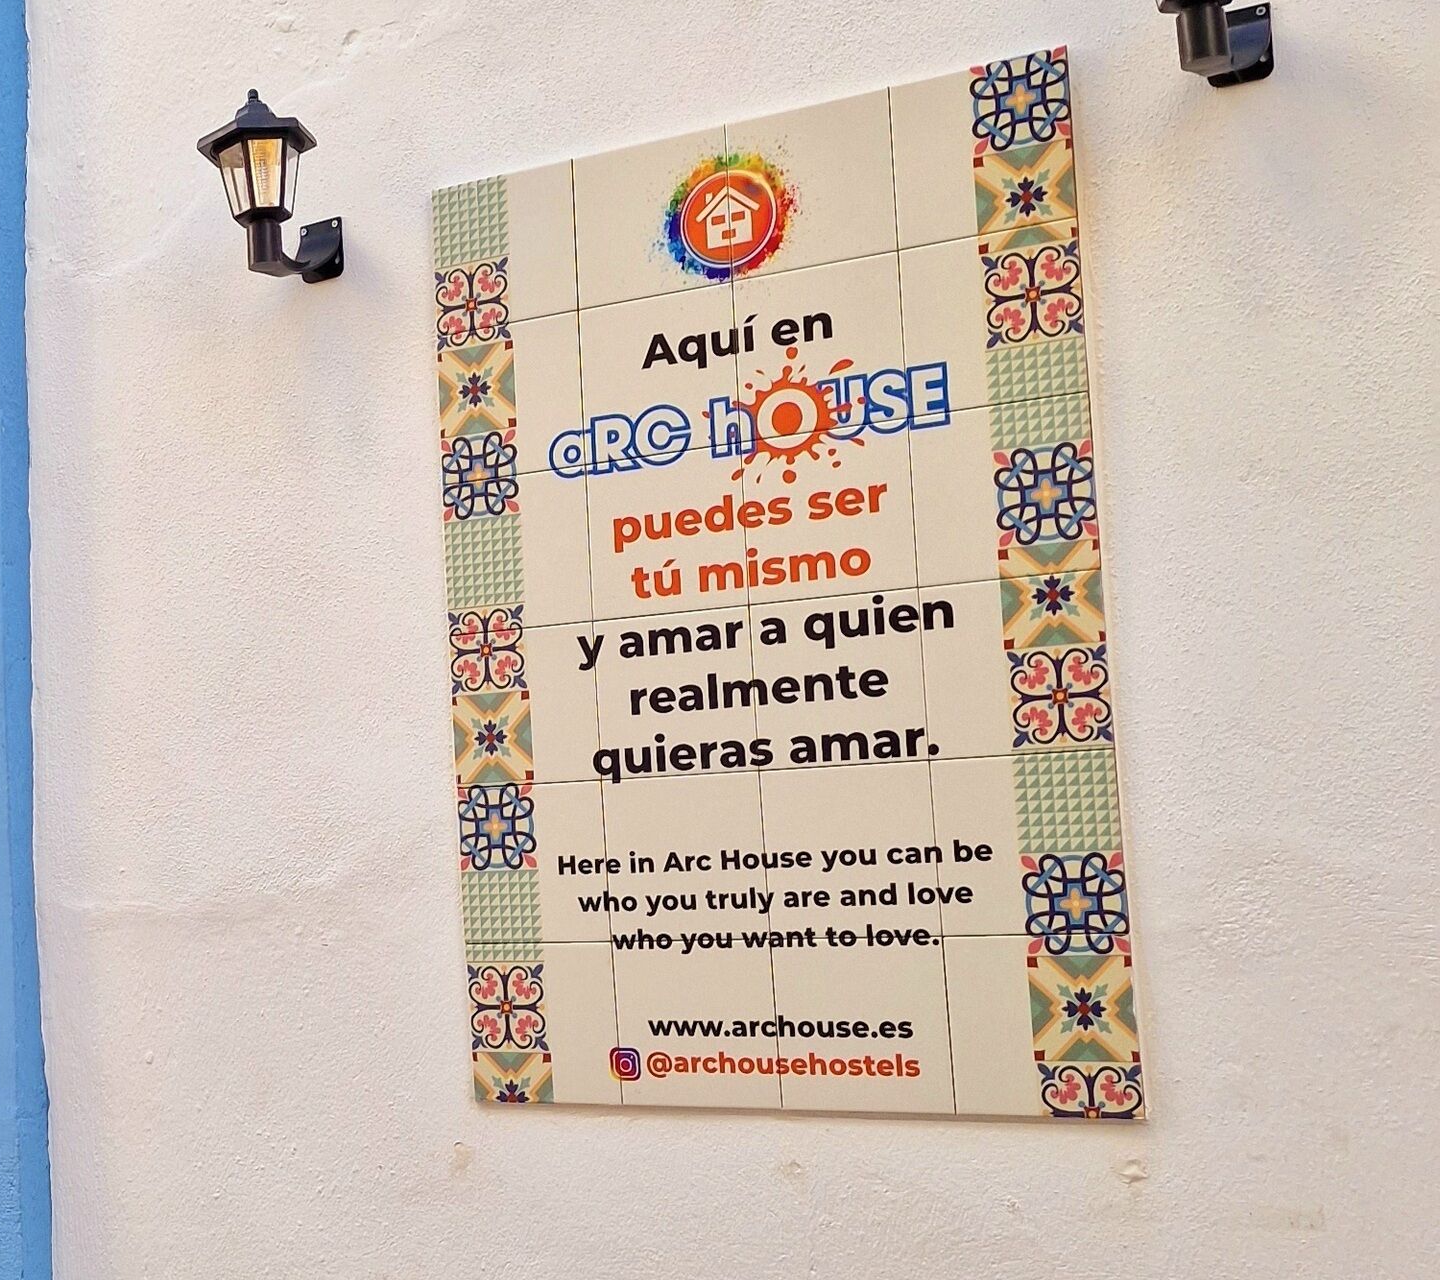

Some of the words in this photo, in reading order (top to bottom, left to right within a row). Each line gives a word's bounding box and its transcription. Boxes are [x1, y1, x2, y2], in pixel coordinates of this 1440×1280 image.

[641, 314, 758, 369] Aquí
[771, 312, 833, 346] en
[613, 495, 792, 553] puedes
[808, 483, 888, 520] ser
[631, 559, 681, 599] tú
[699, 547, 871, 592] mismo
[577, 632, 604, 671] y
[619, 620, 743, 659] amar
[760, 617, 787, 646] a
[804, 594, 954, 649] quien
[630, 666, 889, 715] realmente
[592, 733, 774, 783] quieras
[790, 726, 940, 762] amar.
[558, 855, 621, 875] Here
[629, 851, 654, 873] in
[663, 852, 711, 872] Arc
[721, 850, 812, 870] House
[821, 849, 877, 872] you
[887, 846, 942, 864] can
[953, 839, 993, 862] be
[578, 891, 637, 912] who
[645, 894, 696, 917] you
[705, 887, 774, 914] truly
[784, 889, 830, 907] are
[840, 883, 897, 907] and
[908, 882, 974, 904] love
[612, 928, 672, 949] who
[681, 932, 732, 954] you
[742, 927, 817, 948] want
[825, 927, 857, 947] to
[867, 924, 940, 946] love.
[648, 1015, 914, 1039] www.archouse.es
[646, 1052, 921, 1078] @archousehostels
